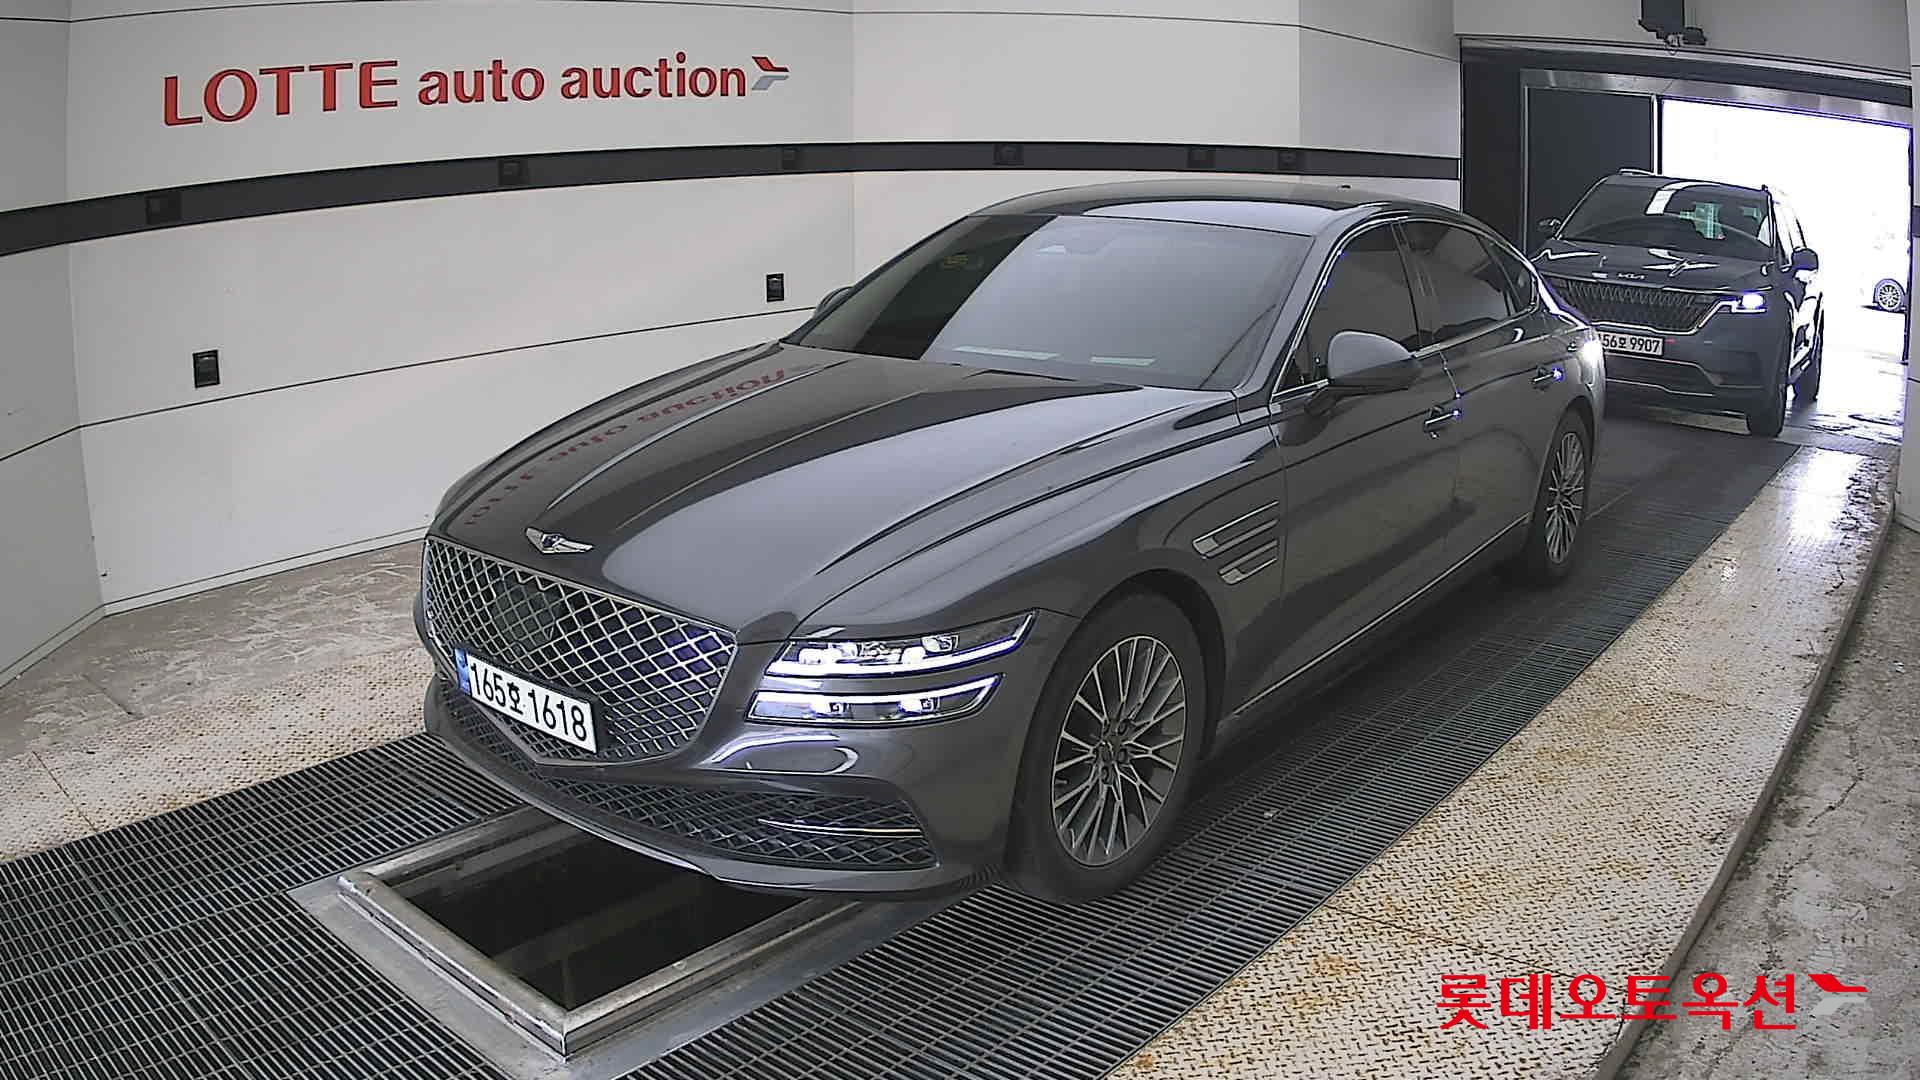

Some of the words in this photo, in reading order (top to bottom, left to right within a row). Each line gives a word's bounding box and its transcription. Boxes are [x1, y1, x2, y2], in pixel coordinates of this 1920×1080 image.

[164, 59, 399, 126] LOTTE
[417, 59, 545, 106] auto
[560, 51, 748, 100] auction
[1630, 336, 1661, 353] 9907
[470, 662, 524, 716] 165호
[527, 689, 588, 742] 1618
